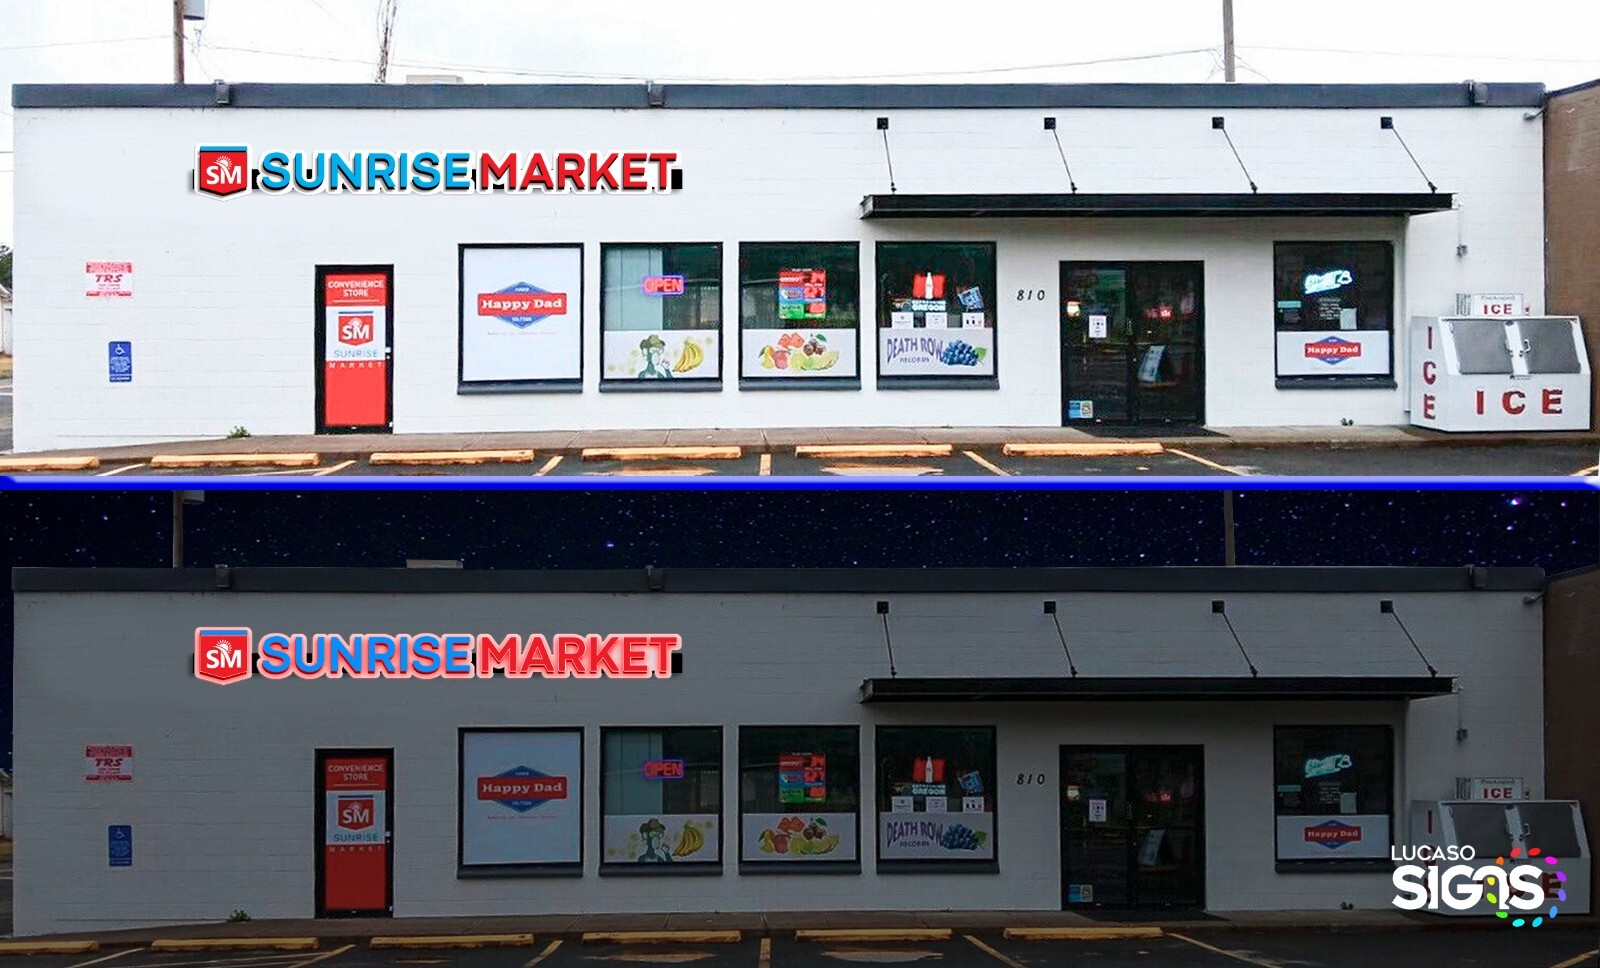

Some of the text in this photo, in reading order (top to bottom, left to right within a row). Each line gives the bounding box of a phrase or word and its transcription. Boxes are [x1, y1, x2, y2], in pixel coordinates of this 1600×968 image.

[206, 152, 678, 190] SM SUNRISE MARKET
[95, 274, 123, 283] TRS
[328, 280, 384, 289] CONVENIENCE
[644, 278, 682, 292] OPEN
[343, 289, 369, 297] STORE
[1017, 289, 1045, 301] 810
[482, 298, 563, 310] Happy Dad
[1483, 303, 1513, 315] ICE
[342, 324, 370, 340] SM
[334, 349, 378, 358] SUNRISE
[887, 337, 943, 364] DEATH ROW
[1307, 345, 1359, 355] Happy Dad
[1423, 326, 1437, 420] ICE
[1476, 388, 1564, 415] ICE
[206, 636, 678, 674] SM SUNRISE MARKET
[328, 764, 384, 773] CONVENIENCE
[644, 762, 682, 776] OPEN
[343, 773, 369, 781] STORE
[1017, 773, 1045, 785] 810
[482, 782, 563, 794] Happy Dad
[1483, 787, 1513, 799] ICE
[342, 808, 370, 824] SM
[334, 833, 378, 842] SUNRISE
[887, 821, 943, 848] DEATH ROW
[1307, 829, 1359, 839] Happy Dad
